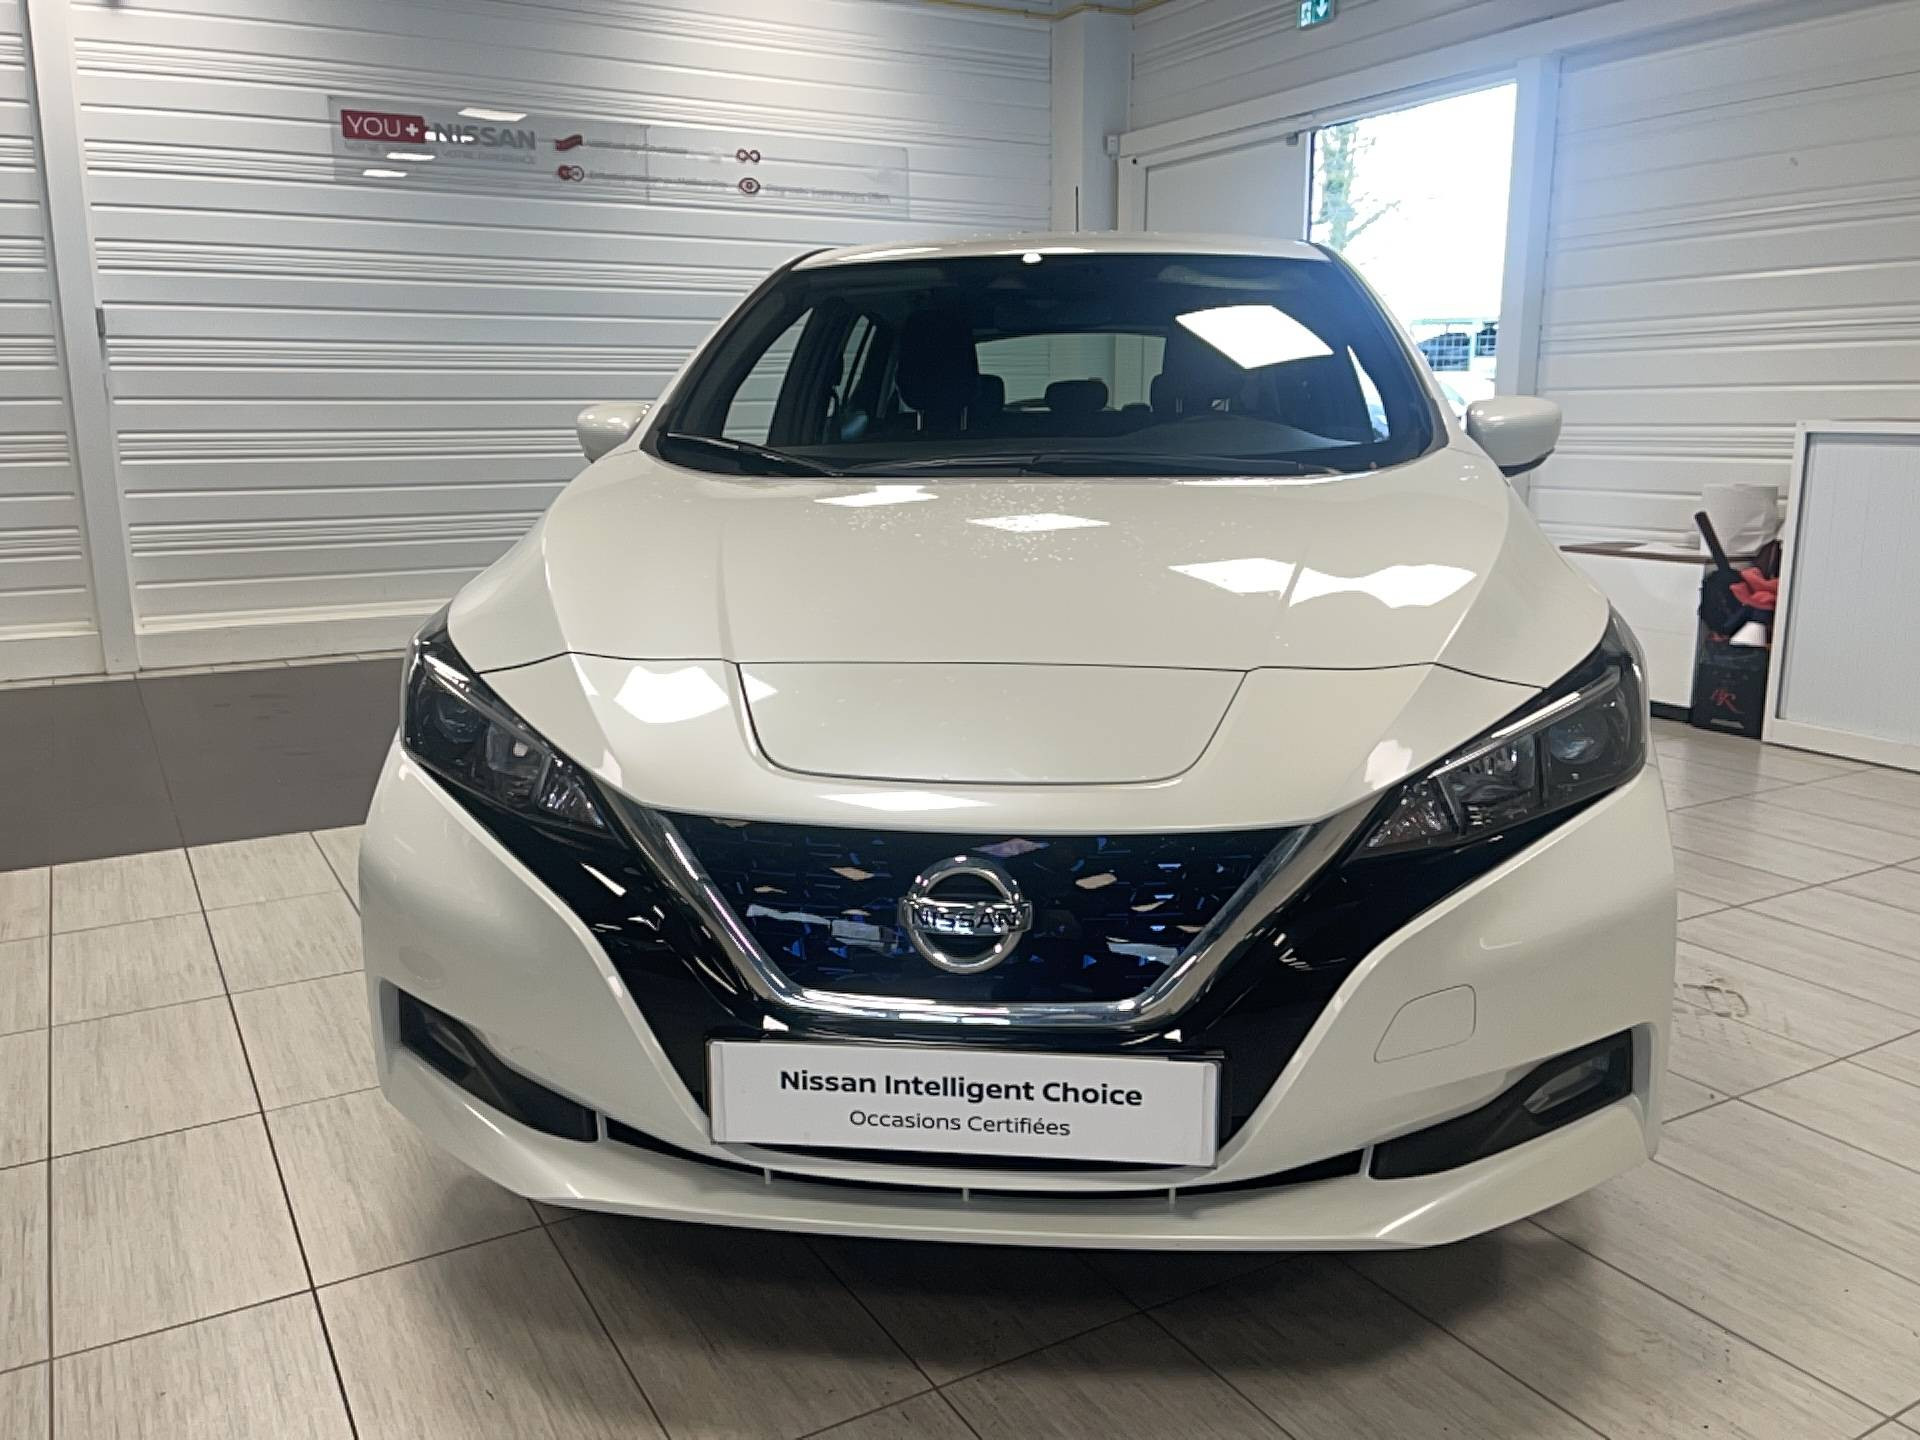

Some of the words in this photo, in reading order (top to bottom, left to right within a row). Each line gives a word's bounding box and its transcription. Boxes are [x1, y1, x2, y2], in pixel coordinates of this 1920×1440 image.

[433, 122, 536, 150] NISSAN
[911, 906, 1020, 930] NISSAN
[780, 1069, 877, 1095] Nissan
[884, 1074, 1035, 1106] Intelligent
[1043, 1081, 1143, 1107] Choice
[849, 1110, 961, 1132] Occasions
[967, 1114, 1071, 1136] Certifiées
